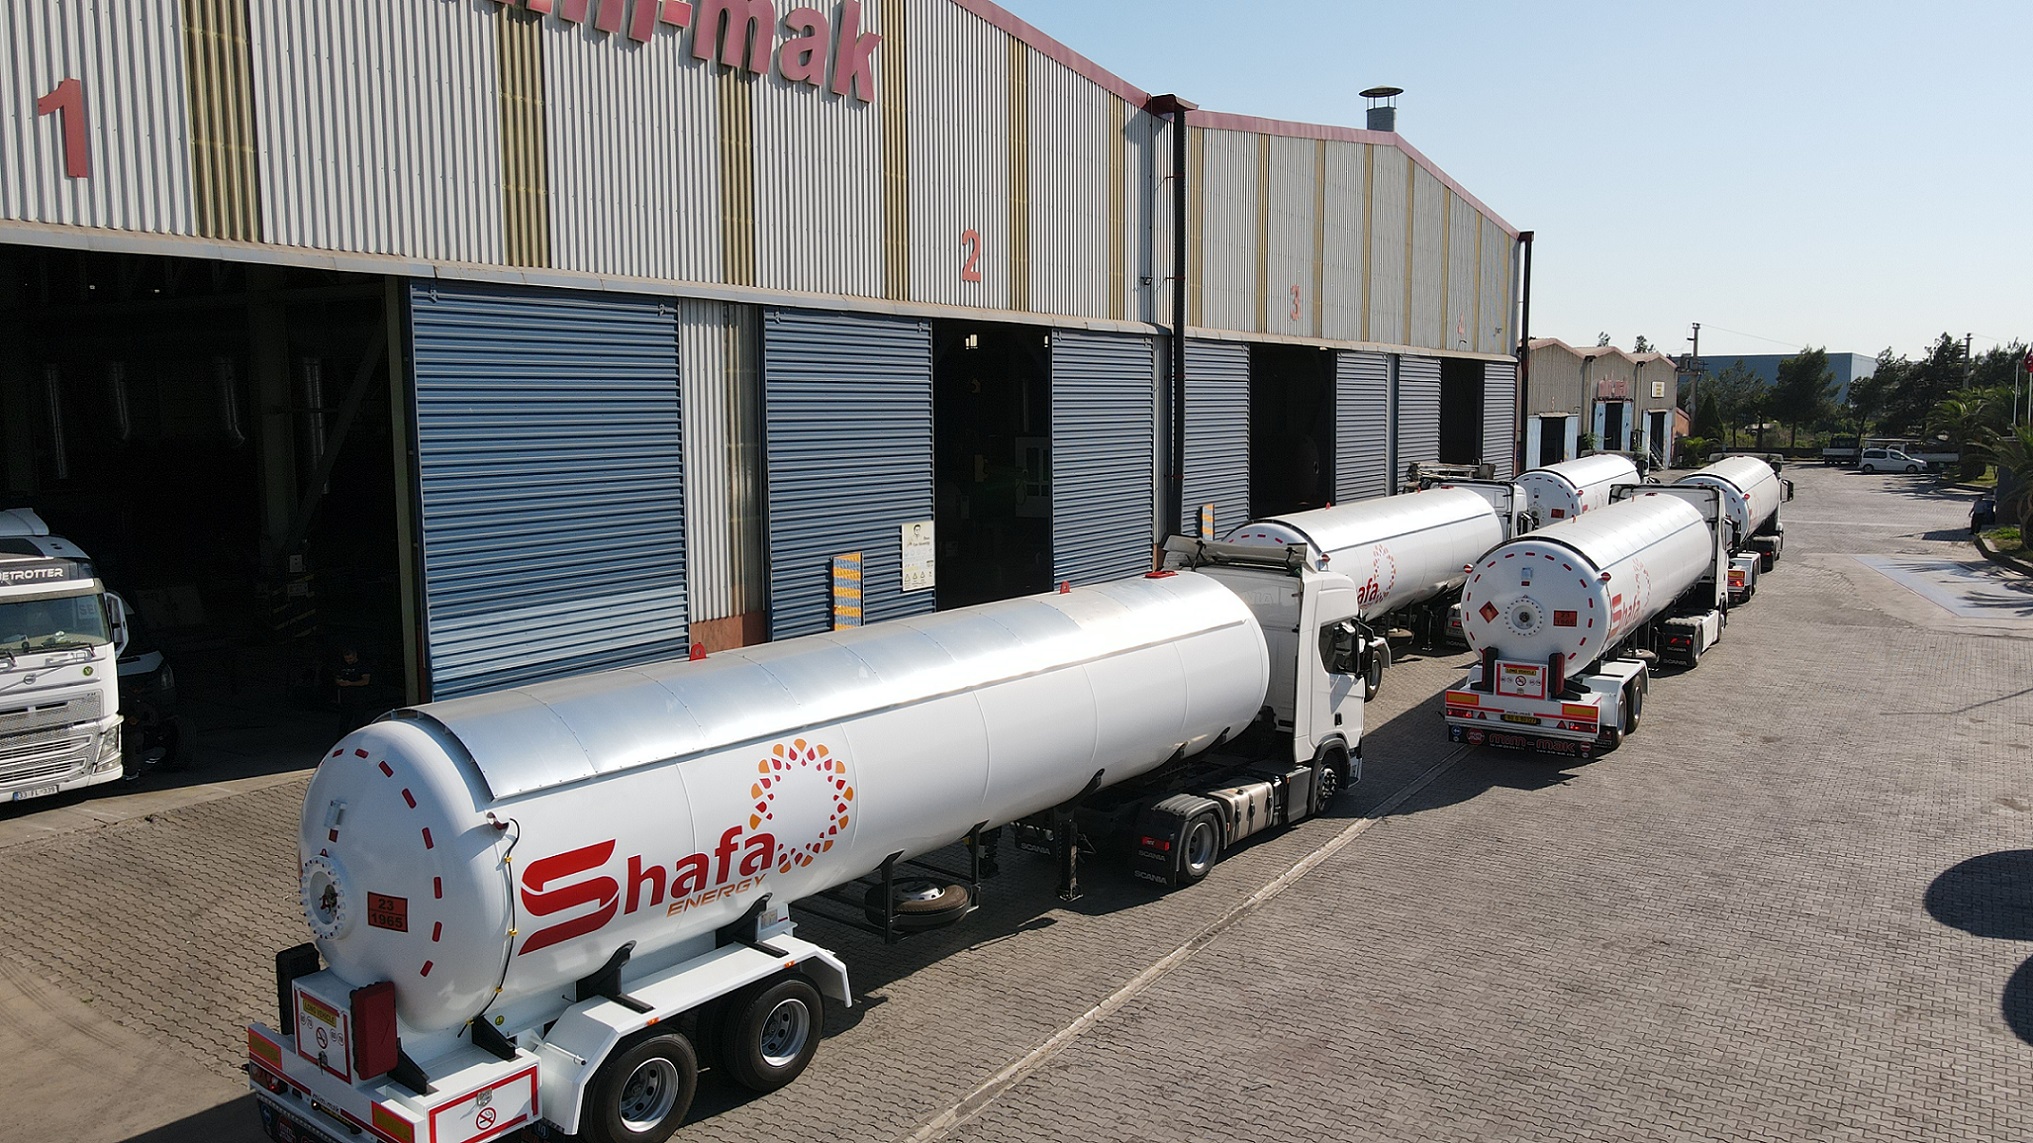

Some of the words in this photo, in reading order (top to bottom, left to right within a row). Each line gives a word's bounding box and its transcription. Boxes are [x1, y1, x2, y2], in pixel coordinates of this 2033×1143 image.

[38, 78, 88, 178] 1
[961, 228, 982, 283] 2
[1290, 284, 1301, 321] 3
[0, 568, 64, 581] ETROTTER
[1138, 849, 1166, 862] SCANIA
[1134, 869, 1168, 885] SCANIA
[378, 897, 395, 911] 23
[518, 825, 778, 957] Shafa
[666, 873, 767, 918] ENERGY
[370, 911, 404, 928] 1965
